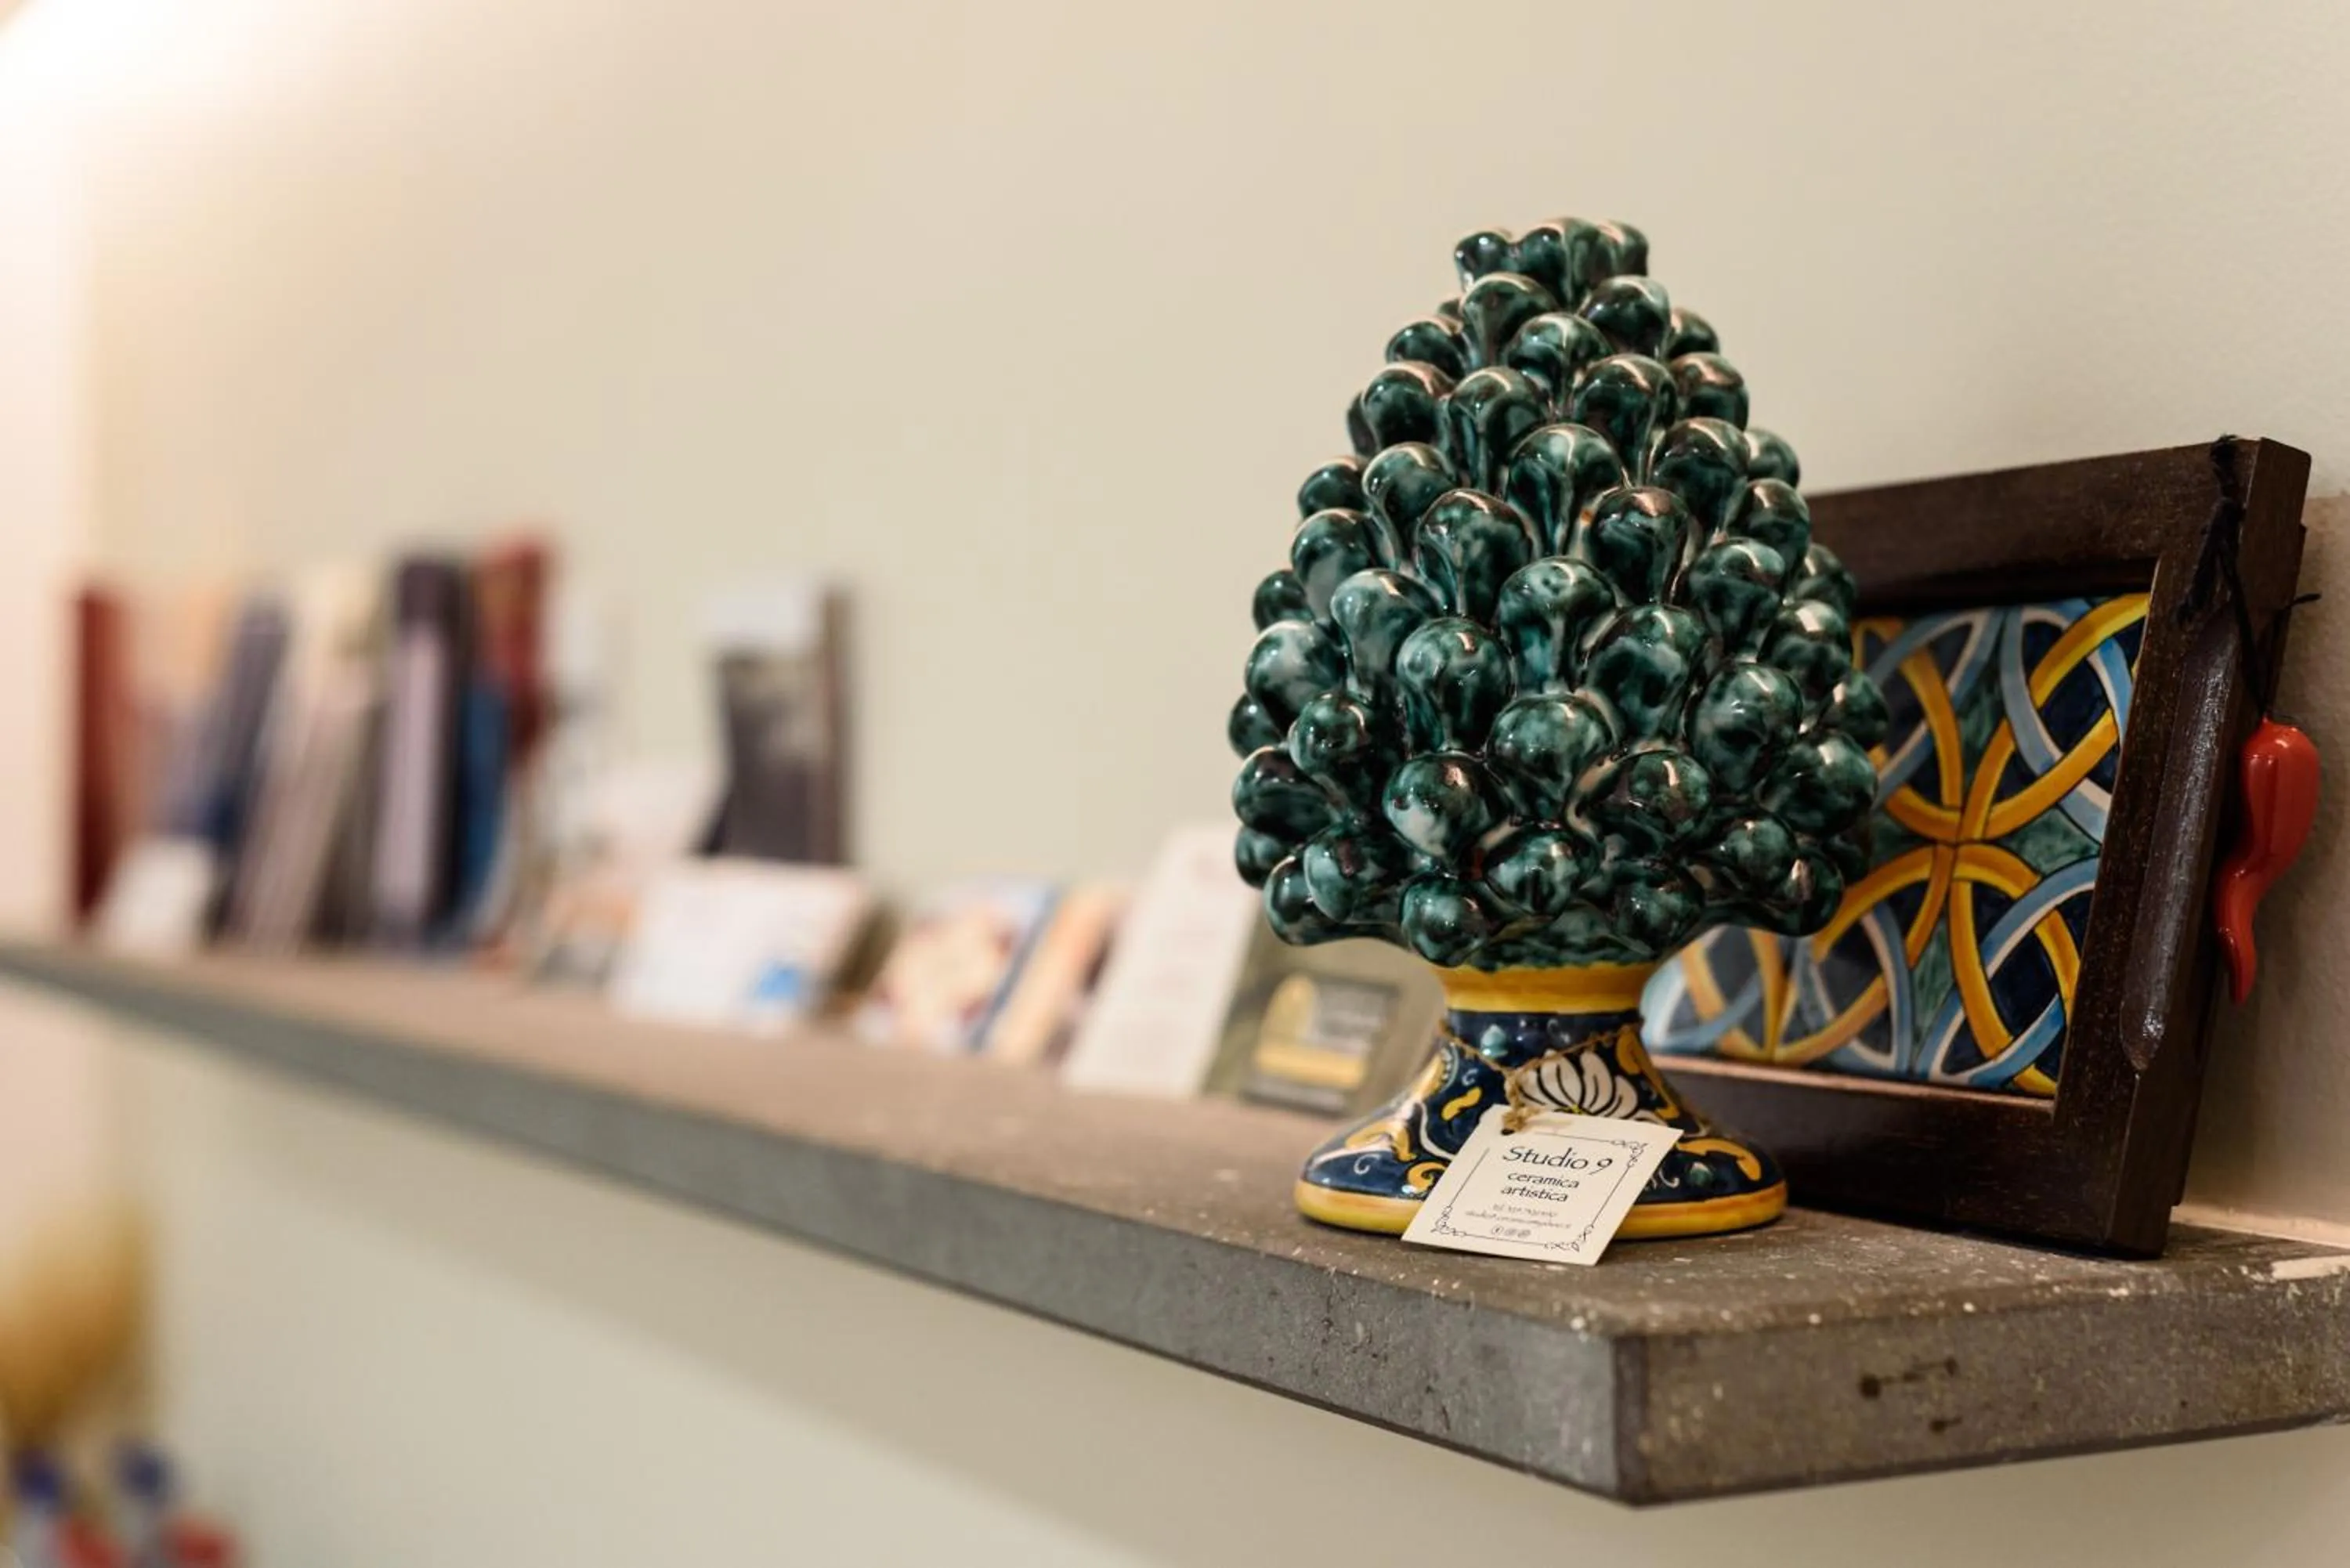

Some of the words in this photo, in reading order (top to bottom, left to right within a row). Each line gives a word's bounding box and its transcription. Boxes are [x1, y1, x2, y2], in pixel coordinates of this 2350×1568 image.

[1502, 1146, 1588, 1169] Studio
[1589, 1158, 1613, 1175] 9
[1507, 1172, 1580, 1188] ceramica
[1501, 1185, 1568, 1201] artistica
